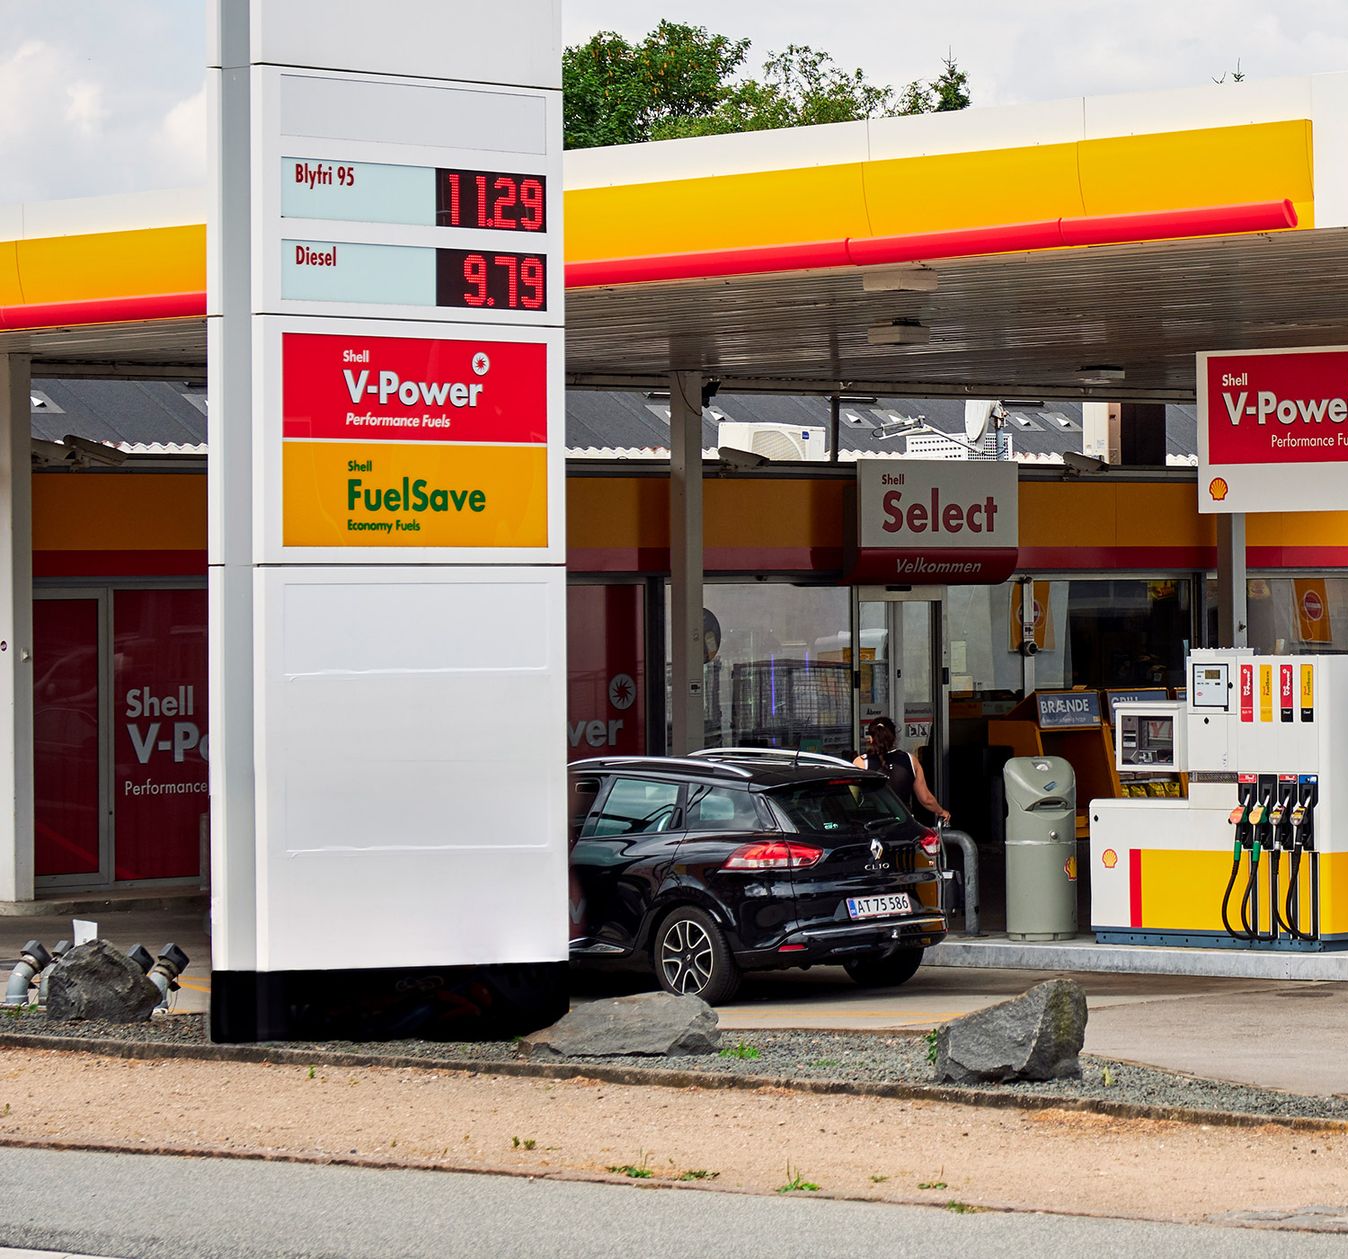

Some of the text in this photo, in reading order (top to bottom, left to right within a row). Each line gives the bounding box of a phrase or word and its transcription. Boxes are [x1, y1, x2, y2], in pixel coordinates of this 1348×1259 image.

[295, 164, 543, 230] Blyfri 95 11.29
[295, 246, 544, 308] Diesel 9.79
[343, 350, 369, 362] Shell
[343, 370, 483, 407] V-Power
[1222, 373, 1248, 387] Shell
[345, 412, 450, 428] Performance Fuels
[1271, 432, 1335, 448] Performance
[347, 460, 372, 472] Shell
[882, 474, 905, 485] Shell
[347, 476, 486, 512] FuelSave
[881, 487, 998, 533] Select
[347, 519, 420, 534] Economy Fuels
[896, 556, 982, 574] Velkommen
[126, 685, 194, 718] Shell
[1040, 699, 1089, 713] BRÆNDE
[125, 778, 208, 796] Performance
[858, 896, 909, 913] AT 75 586
